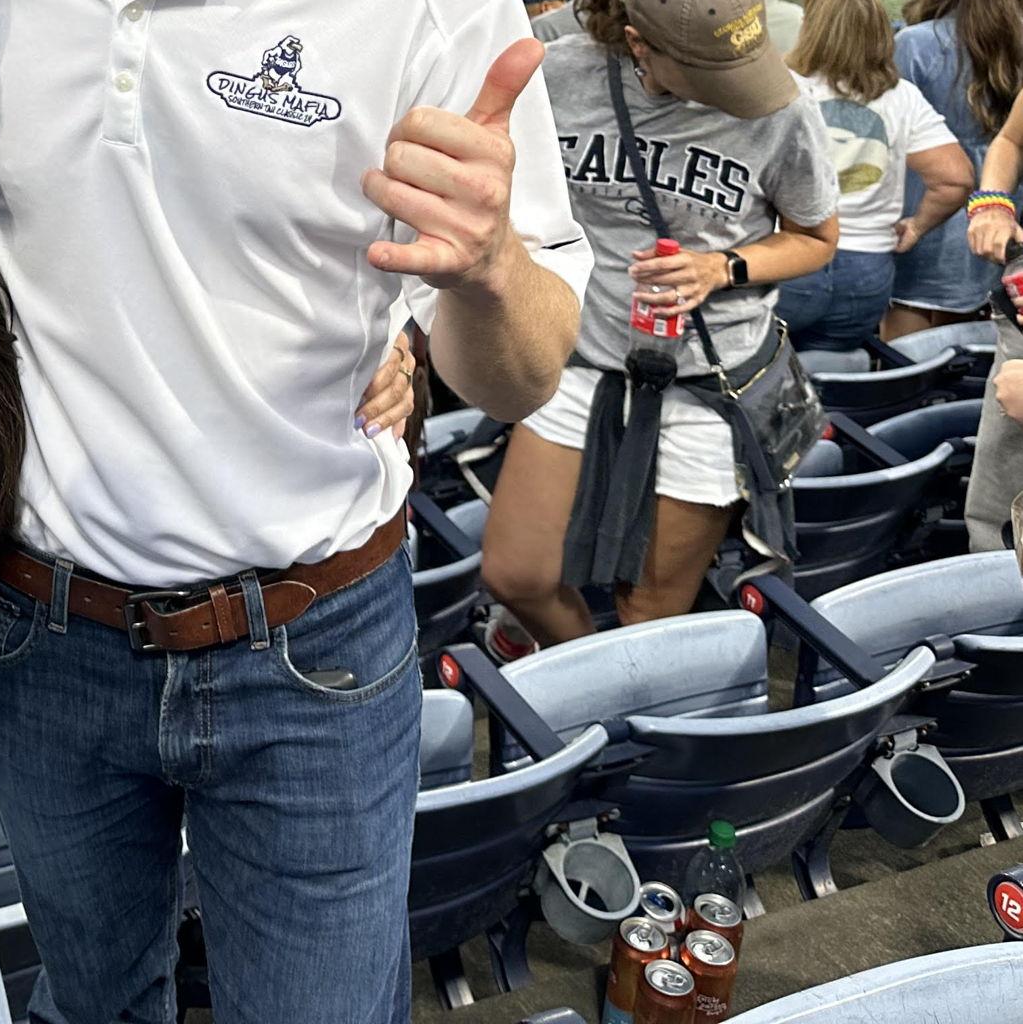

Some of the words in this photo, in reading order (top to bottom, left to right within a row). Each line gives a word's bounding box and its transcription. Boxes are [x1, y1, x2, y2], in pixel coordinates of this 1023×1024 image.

[218, 78, 279, 105] DINGUS
[282, 94, 329, 117] MAFIA
[228, 95, 264, 109] SOUTHERN
[276, 108, 303, 120] CLASSIC
[1001, 892, 1022, 923] 12
